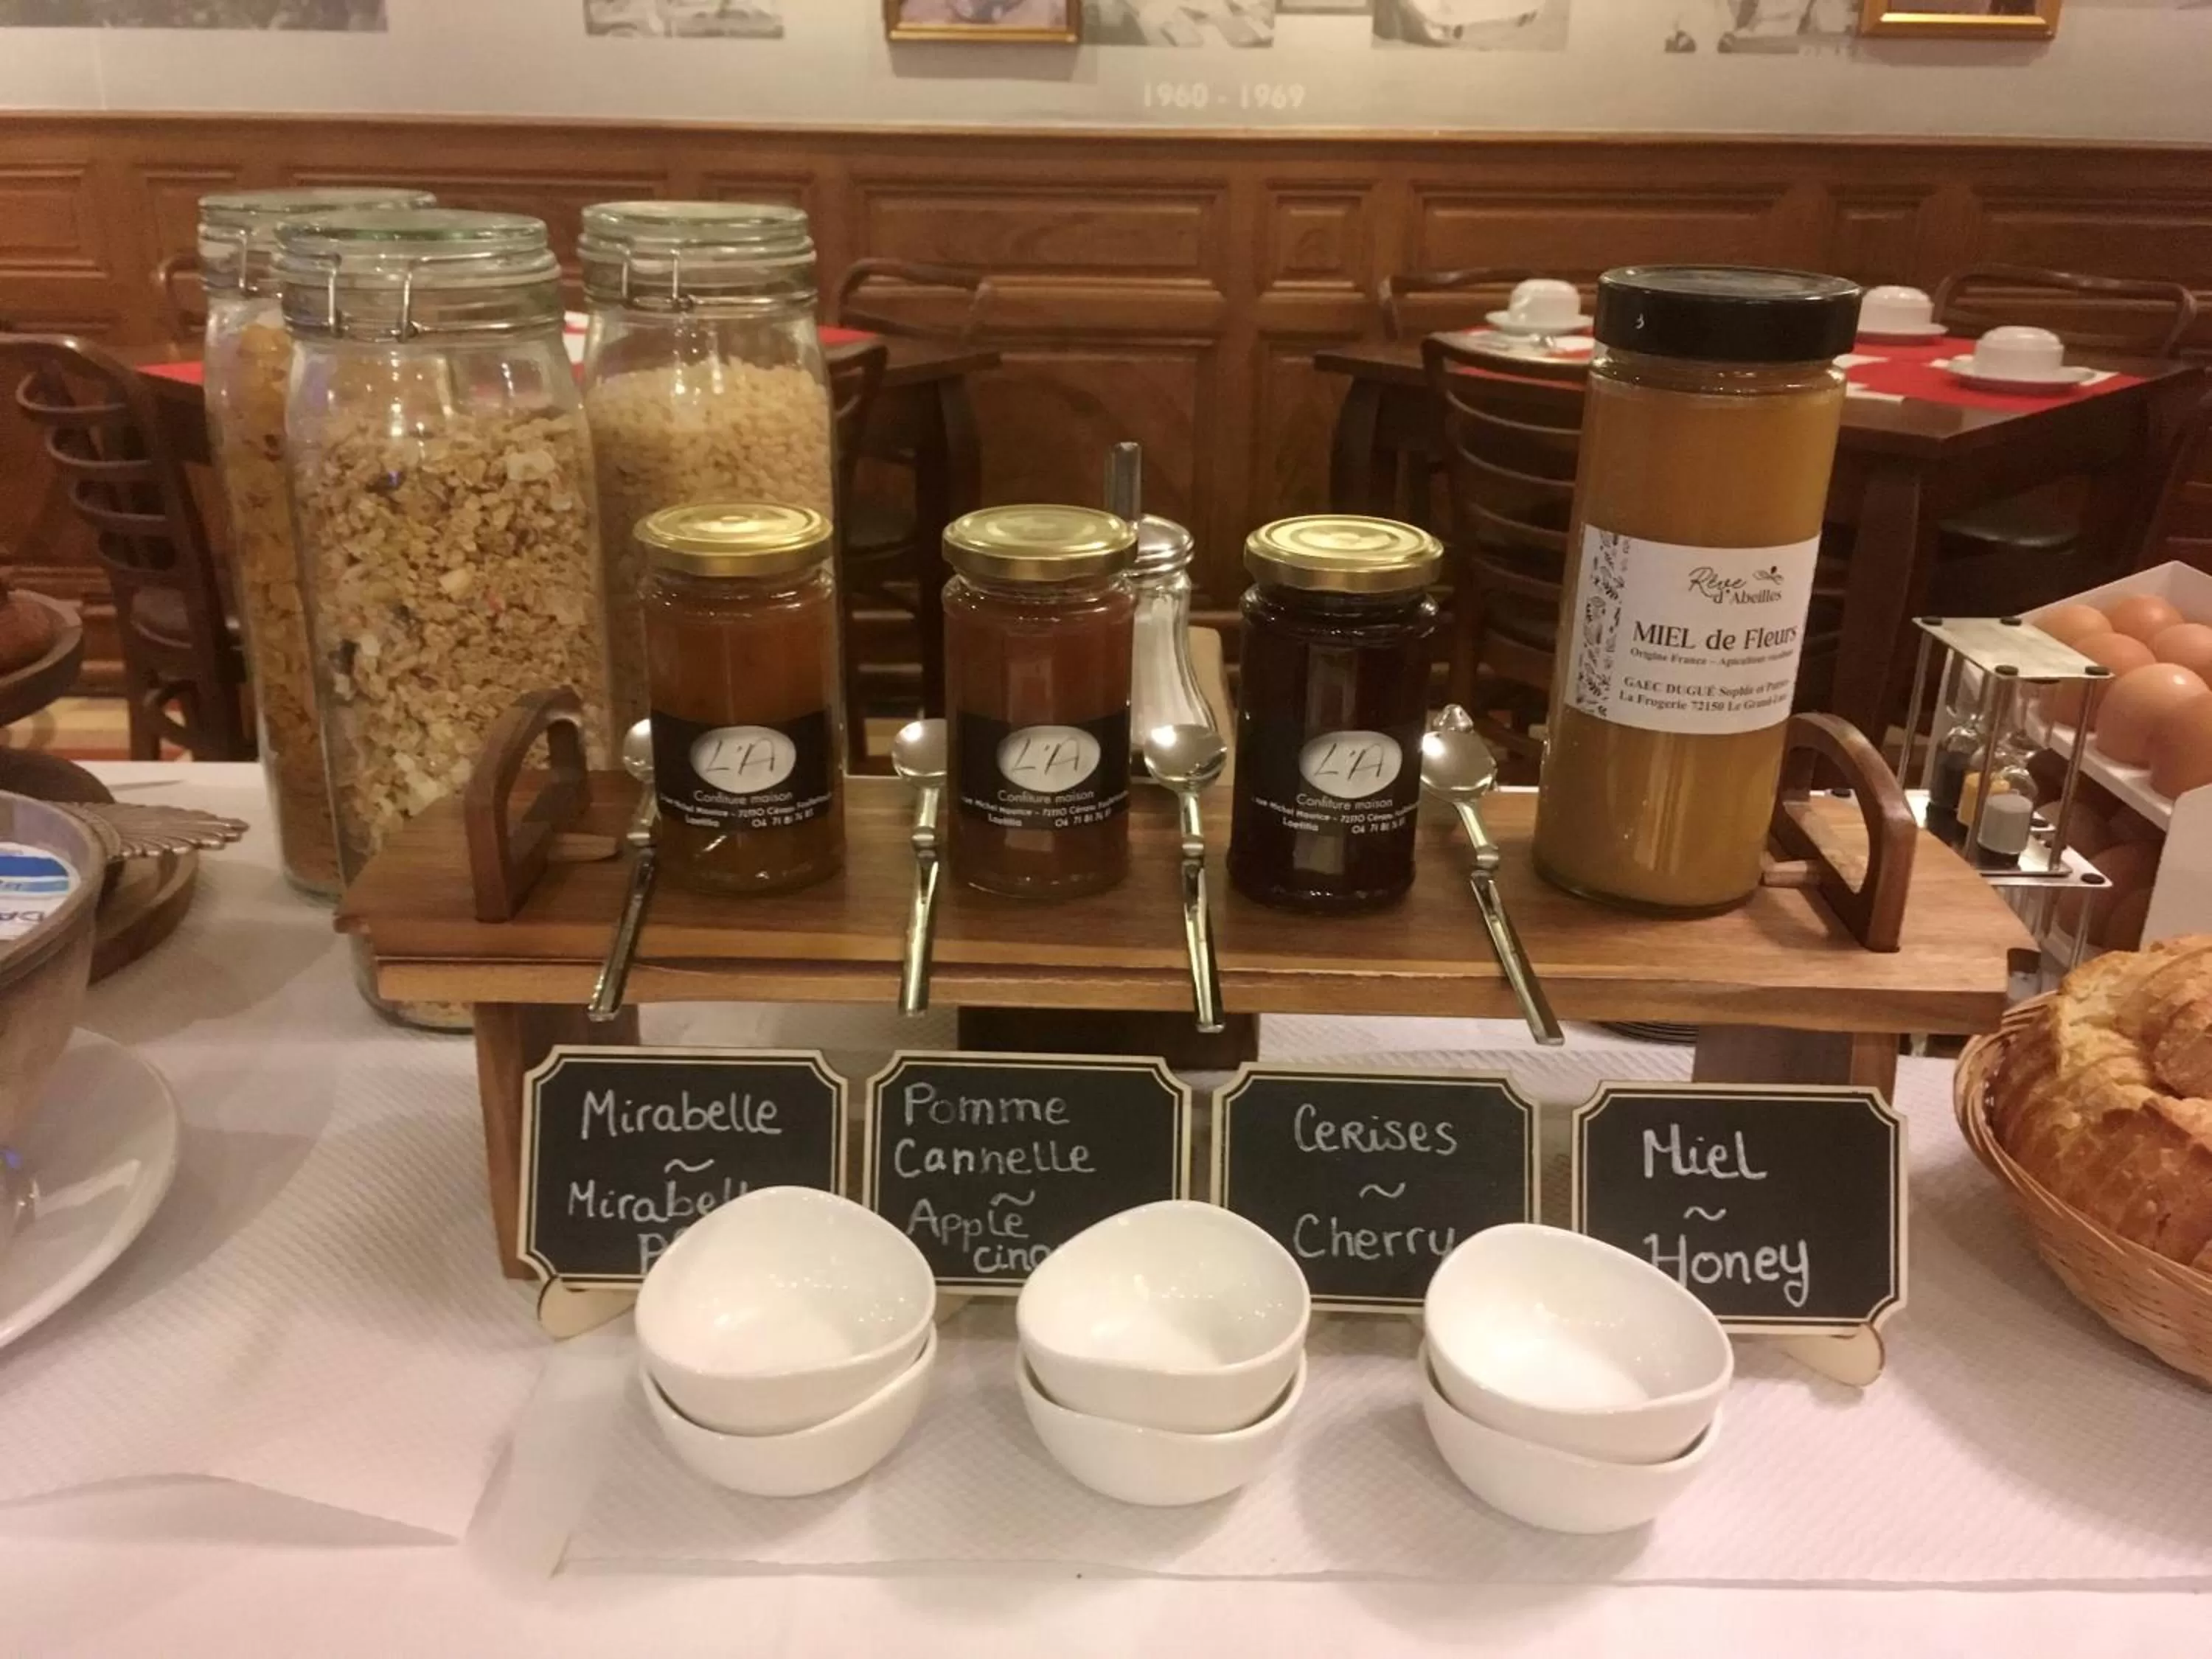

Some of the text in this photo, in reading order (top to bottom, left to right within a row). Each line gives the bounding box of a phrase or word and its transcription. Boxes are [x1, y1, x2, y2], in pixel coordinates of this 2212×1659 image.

[1144, 82, 1208, 108] 1960
[1239, 83, 1306, 109] 1969
[1632, 621, 1798, 650] MIEL de Fleurs
[1630, 647, 1667, 661] Origine
[1670, 653, 1708, 665] France
[1619, 689, 1634, 703] La
[1623, 676, 1662, 692] GAEC
[693, 790, 747, 806] Confiture
[750, 791, 793, 804] maison
[997, 789, 1051, 804] Confiture
[1055, 790, 1095, 804] maison
[1296, 793, 1351, 810] Confiture
[1354, 798, 1393, 810] maison
[580, 1088, 782, 1140] Mirabelle
[904, 1082, 1070, 1127] Pomme
[894, 1138, 1096, 1178] Cannelle
[1643, 1123, 1768, 1180] Miel
[906, 1197, 1030, 1253] Apple
[1643, 1233, 1809, 1308] Honey
